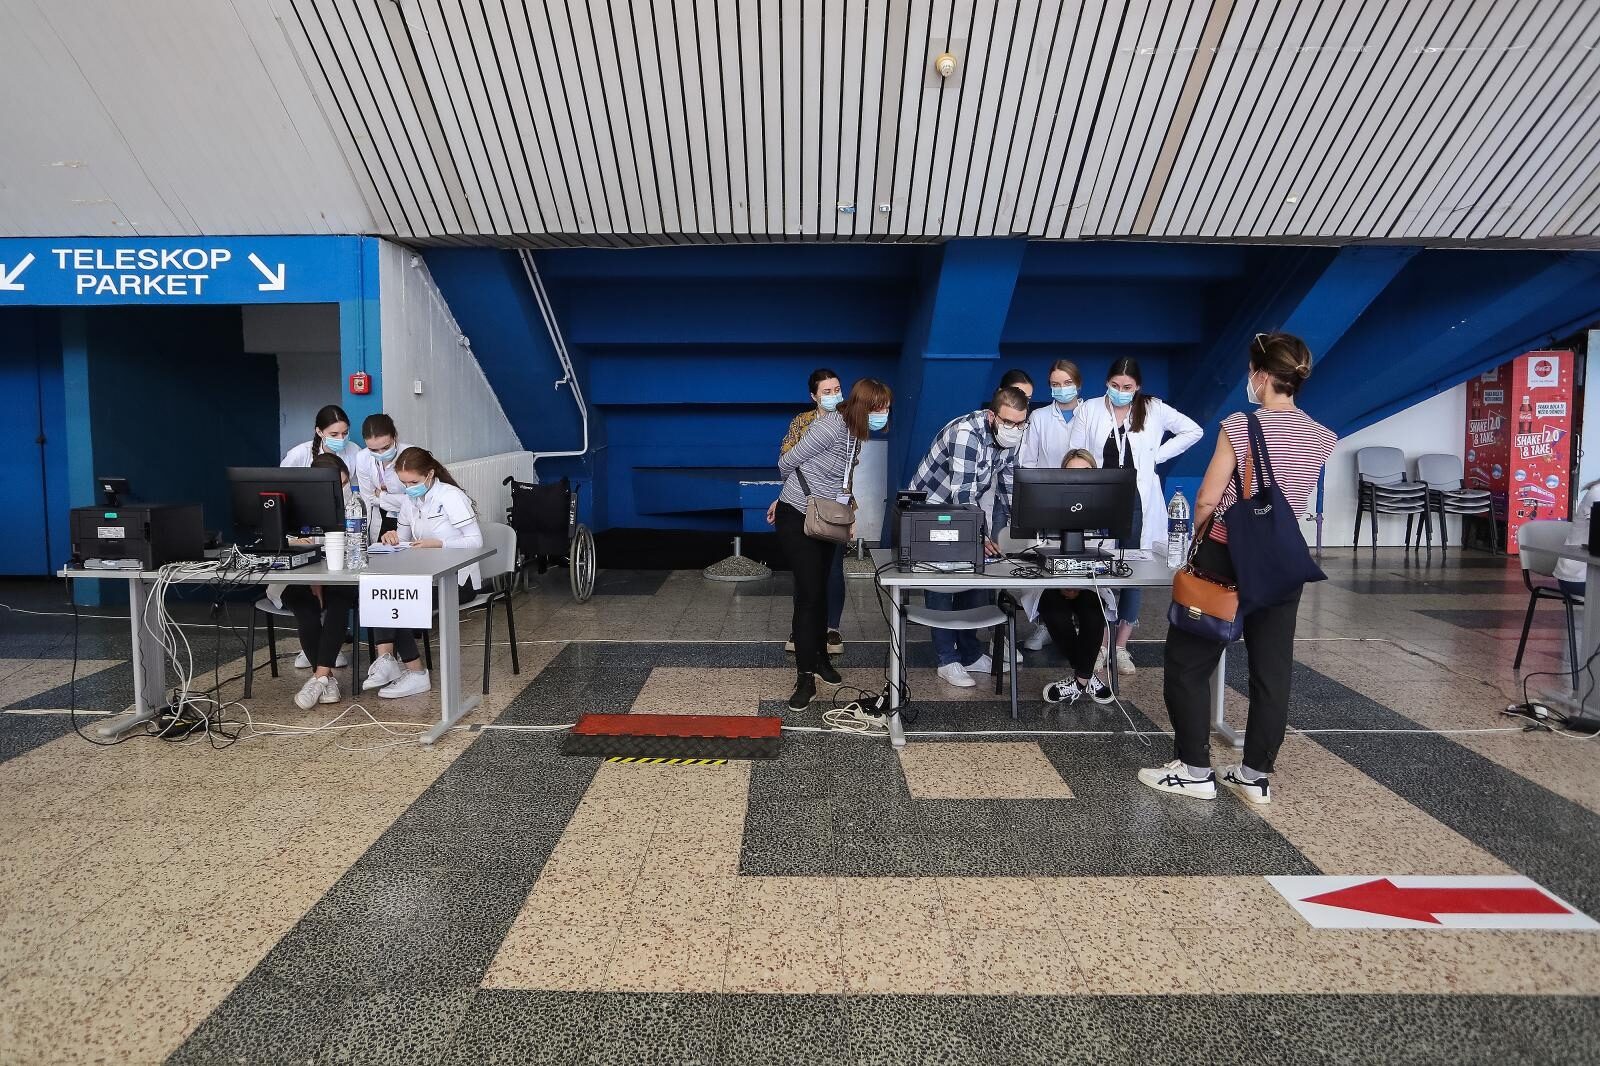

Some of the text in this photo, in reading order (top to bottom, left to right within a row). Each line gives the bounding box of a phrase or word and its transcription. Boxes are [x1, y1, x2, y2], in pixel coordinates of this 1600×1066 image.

[51, 248, 231, 270] TELESKOP
[76, 274, 208, 295] PARKET
[1470, 417, 1501, 433] SHAKE 2.0
[1480, 432, 1494, 444] TAKE
[1517, 430, 1559, 446] SHAKE 2.0
[1523, 443, 1551, 457] & TAKE
[372, 589, 418, 600] PRIJEM
[391, 608, 399, 620] 3
